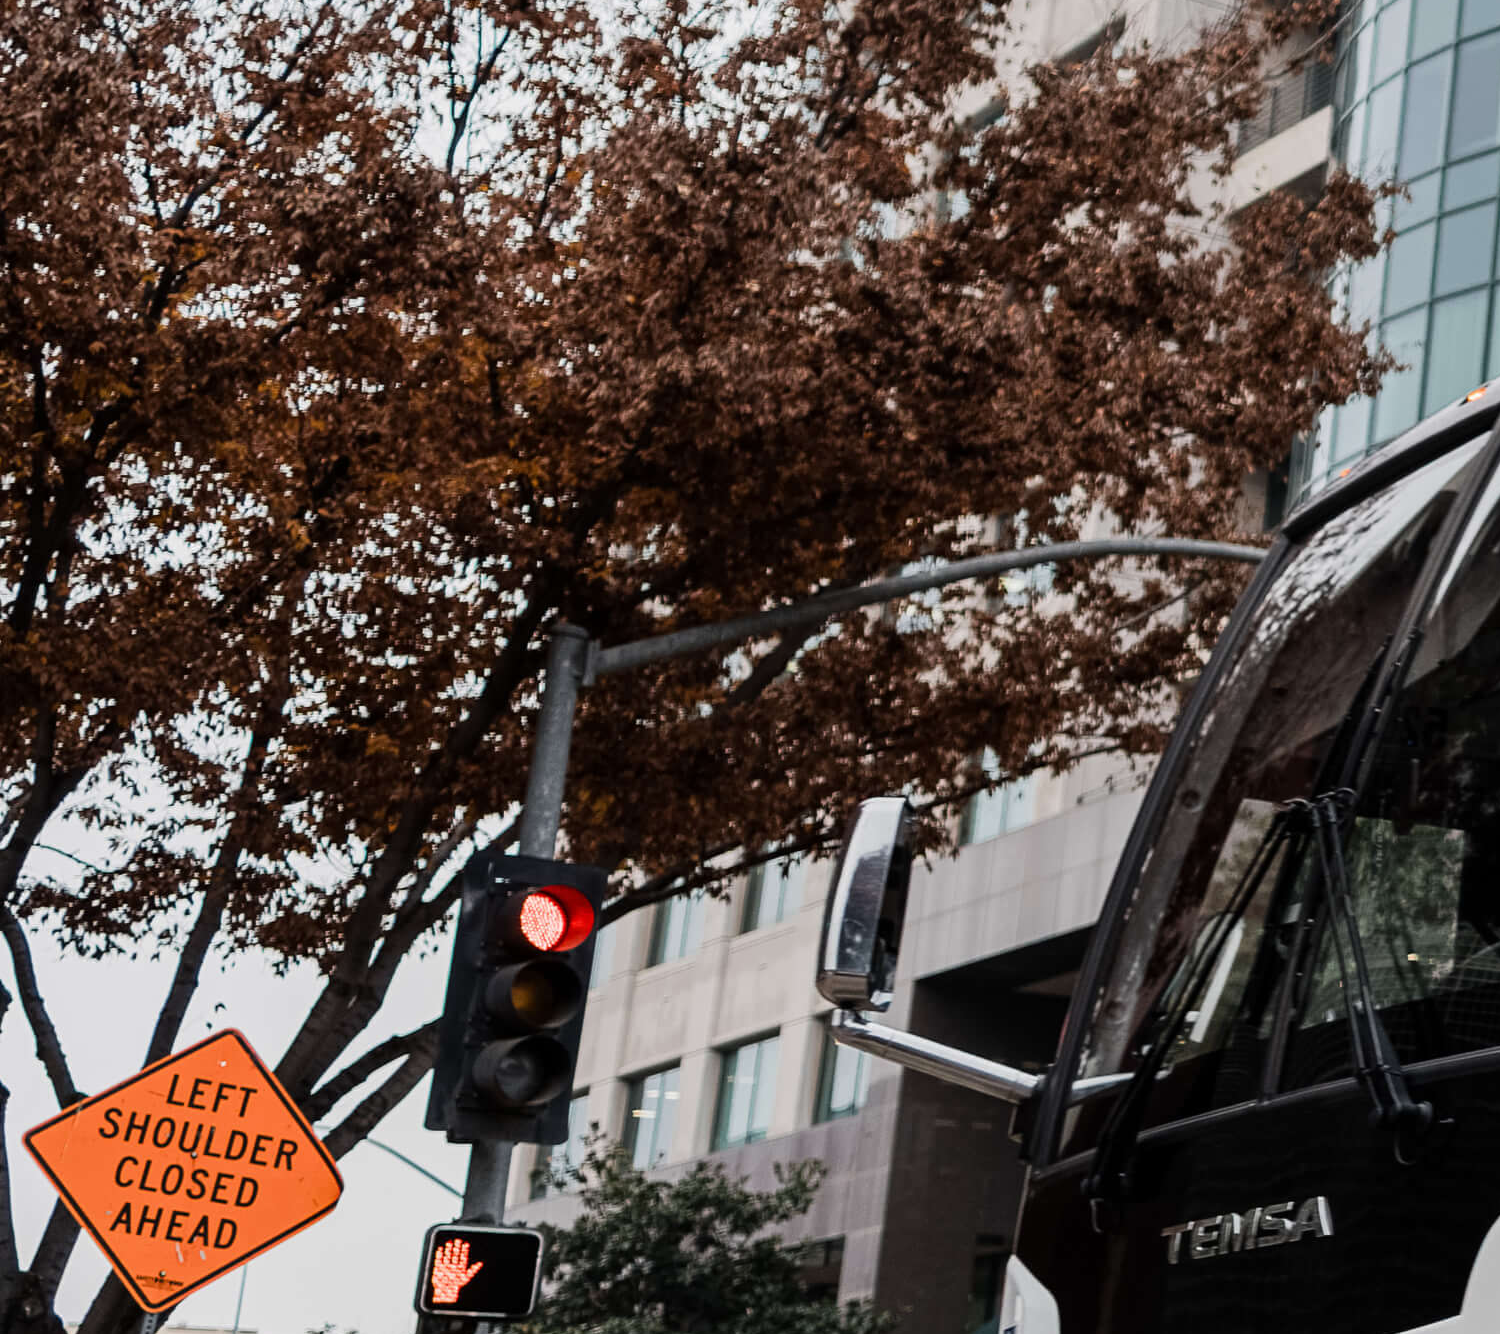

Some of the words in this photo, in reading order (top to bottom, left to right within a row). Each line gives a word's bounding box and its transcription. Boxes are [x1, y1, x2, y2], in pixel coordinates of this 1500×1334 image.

[166, 1074, 257, 1117] LEFT
[98, 1107, 299, 1171] SHOULDER
[114, 1156, 260, 1208] CLOSED
[110, 1202, 238, 1249] AHEAD
[1160, 1196, 1334, 1264] TEMSA
